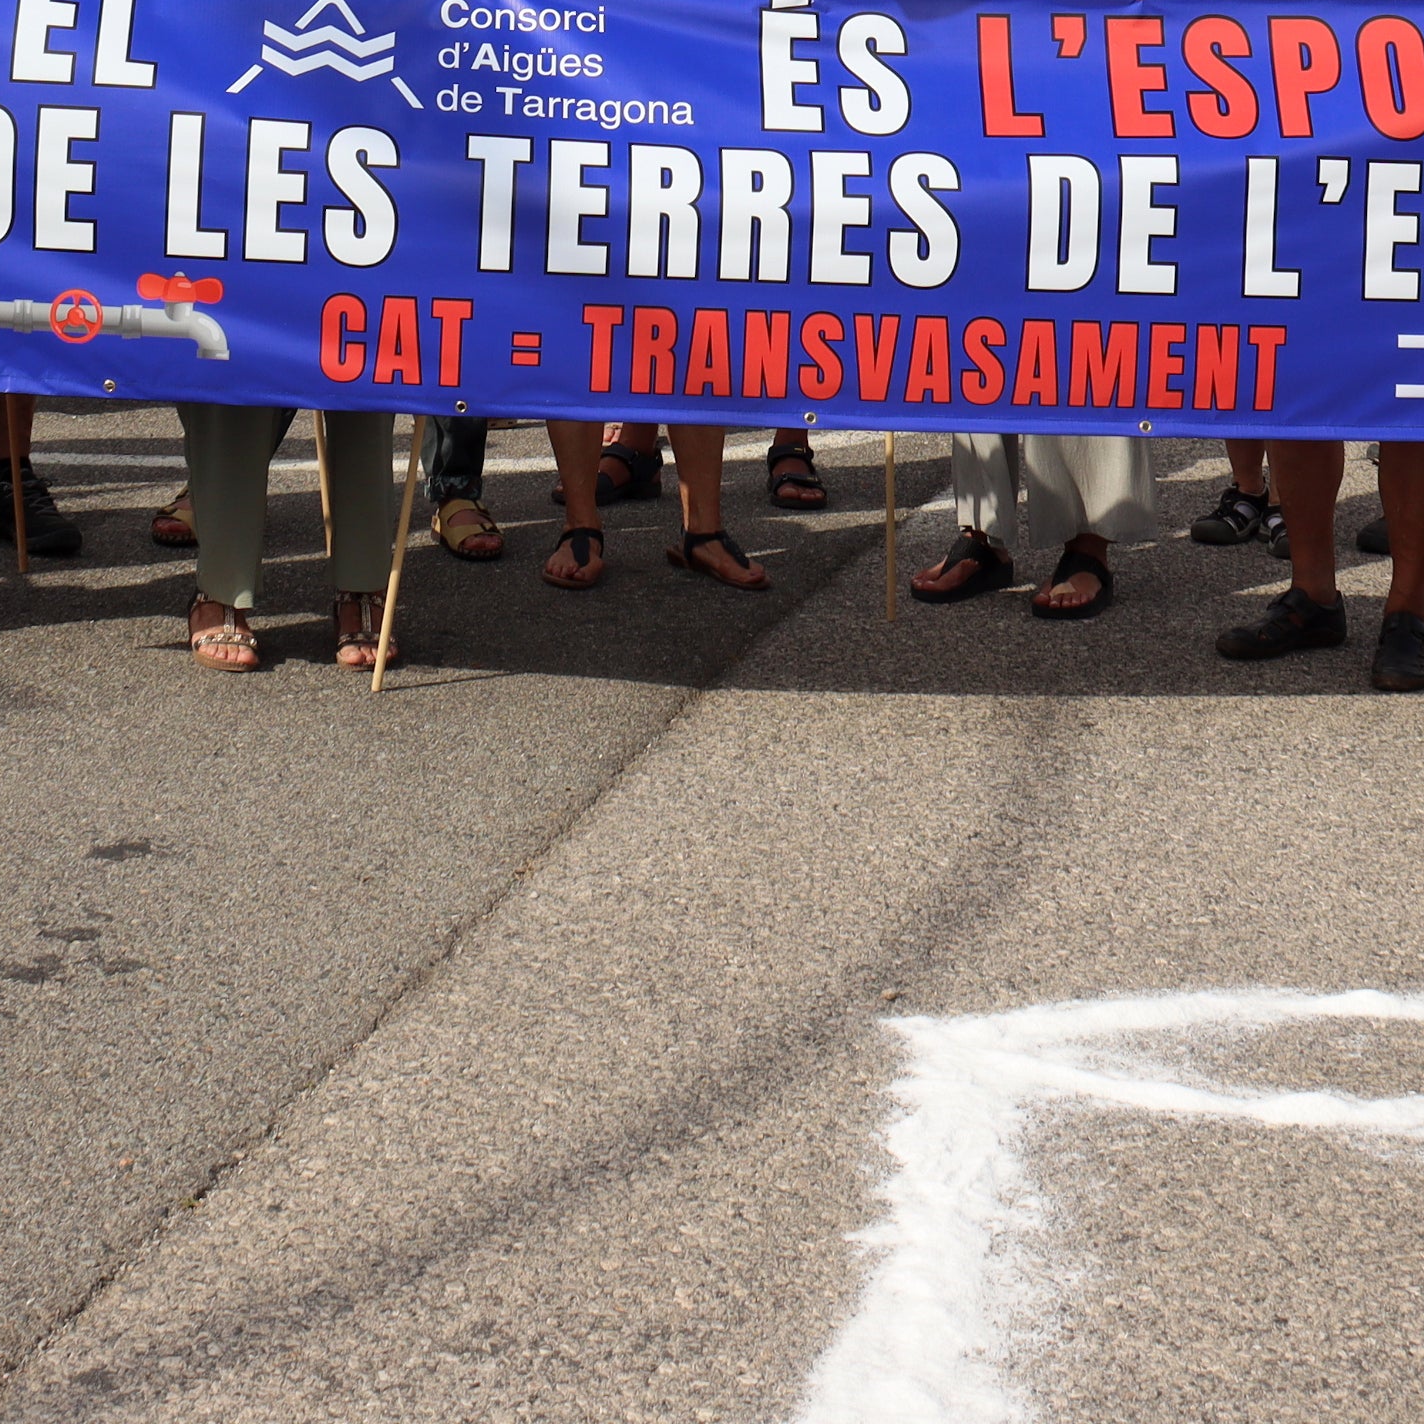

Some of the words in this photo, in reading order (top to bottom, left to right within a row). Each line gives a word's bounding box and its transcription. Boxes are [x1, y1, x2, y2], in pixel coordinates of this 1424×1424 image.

[437, 42, 604, 82] d'Aigües
[436, 84, 483, 113] de
[495, 86, 694, 130] Tarragona
[164, 110, 399, 270] LES
[466, 134, 961, 290] TERRES
[1026, 154, 1178, 295] DE
[318, 293, 474, 388] CAT
[582, 304, 1287, 413] TRANSVASAMENT
